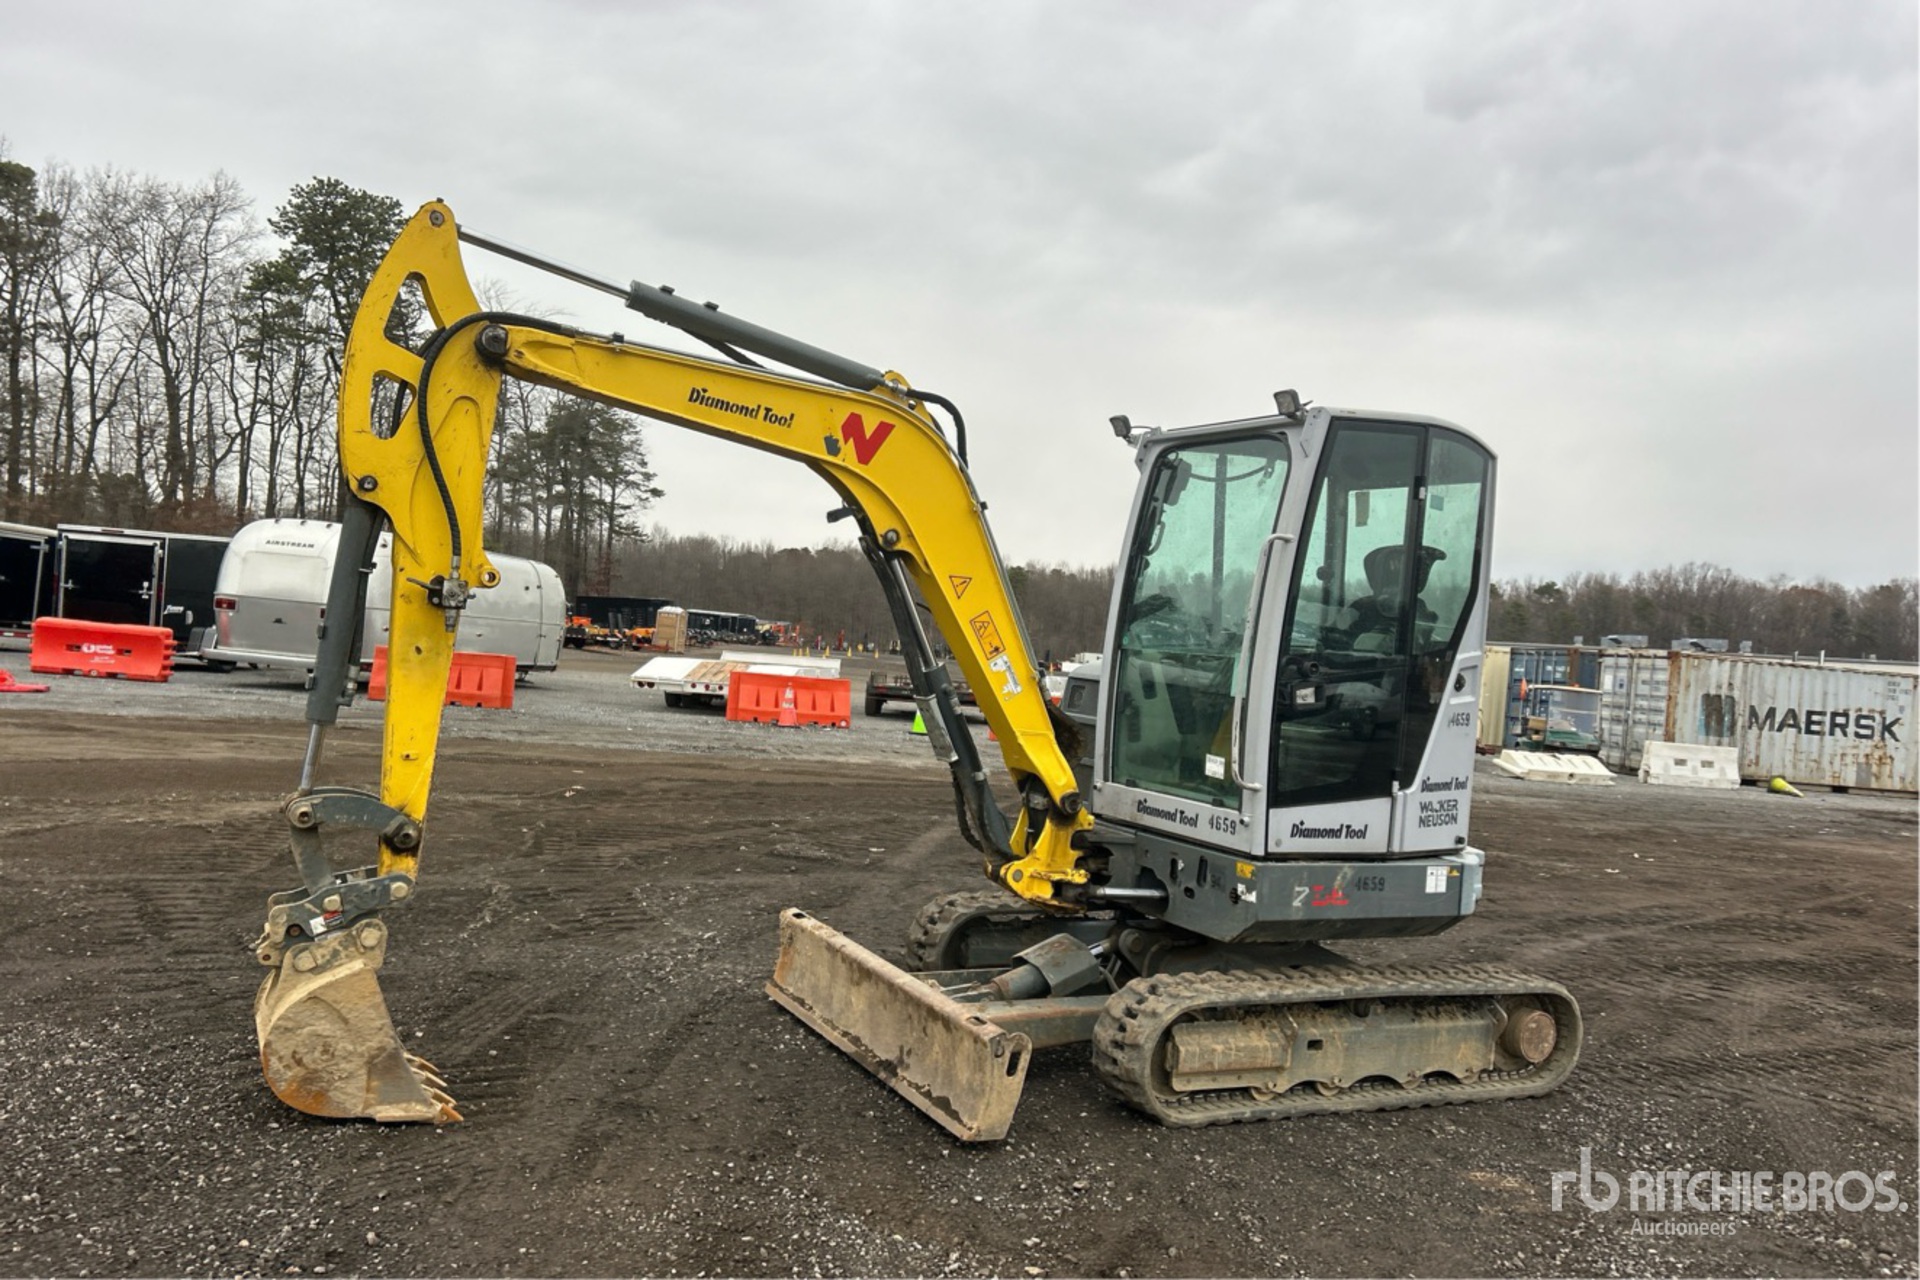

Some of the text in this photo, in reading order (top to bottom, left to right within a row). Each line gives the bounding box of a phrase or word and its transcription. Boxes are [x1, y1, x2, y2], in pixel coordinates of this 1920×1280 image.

[687, 386, 762, 420] Diamond
[1748, 704, 1902, 743] MAERSK
[1421, 776, 1453, 793] Diamond
[1136, 797, 1237, 836] Diamond Tool 4659
[1290, 819, 1368, 839] Diamond Tool
[1418, 813, 1459, 828] NEUSON
